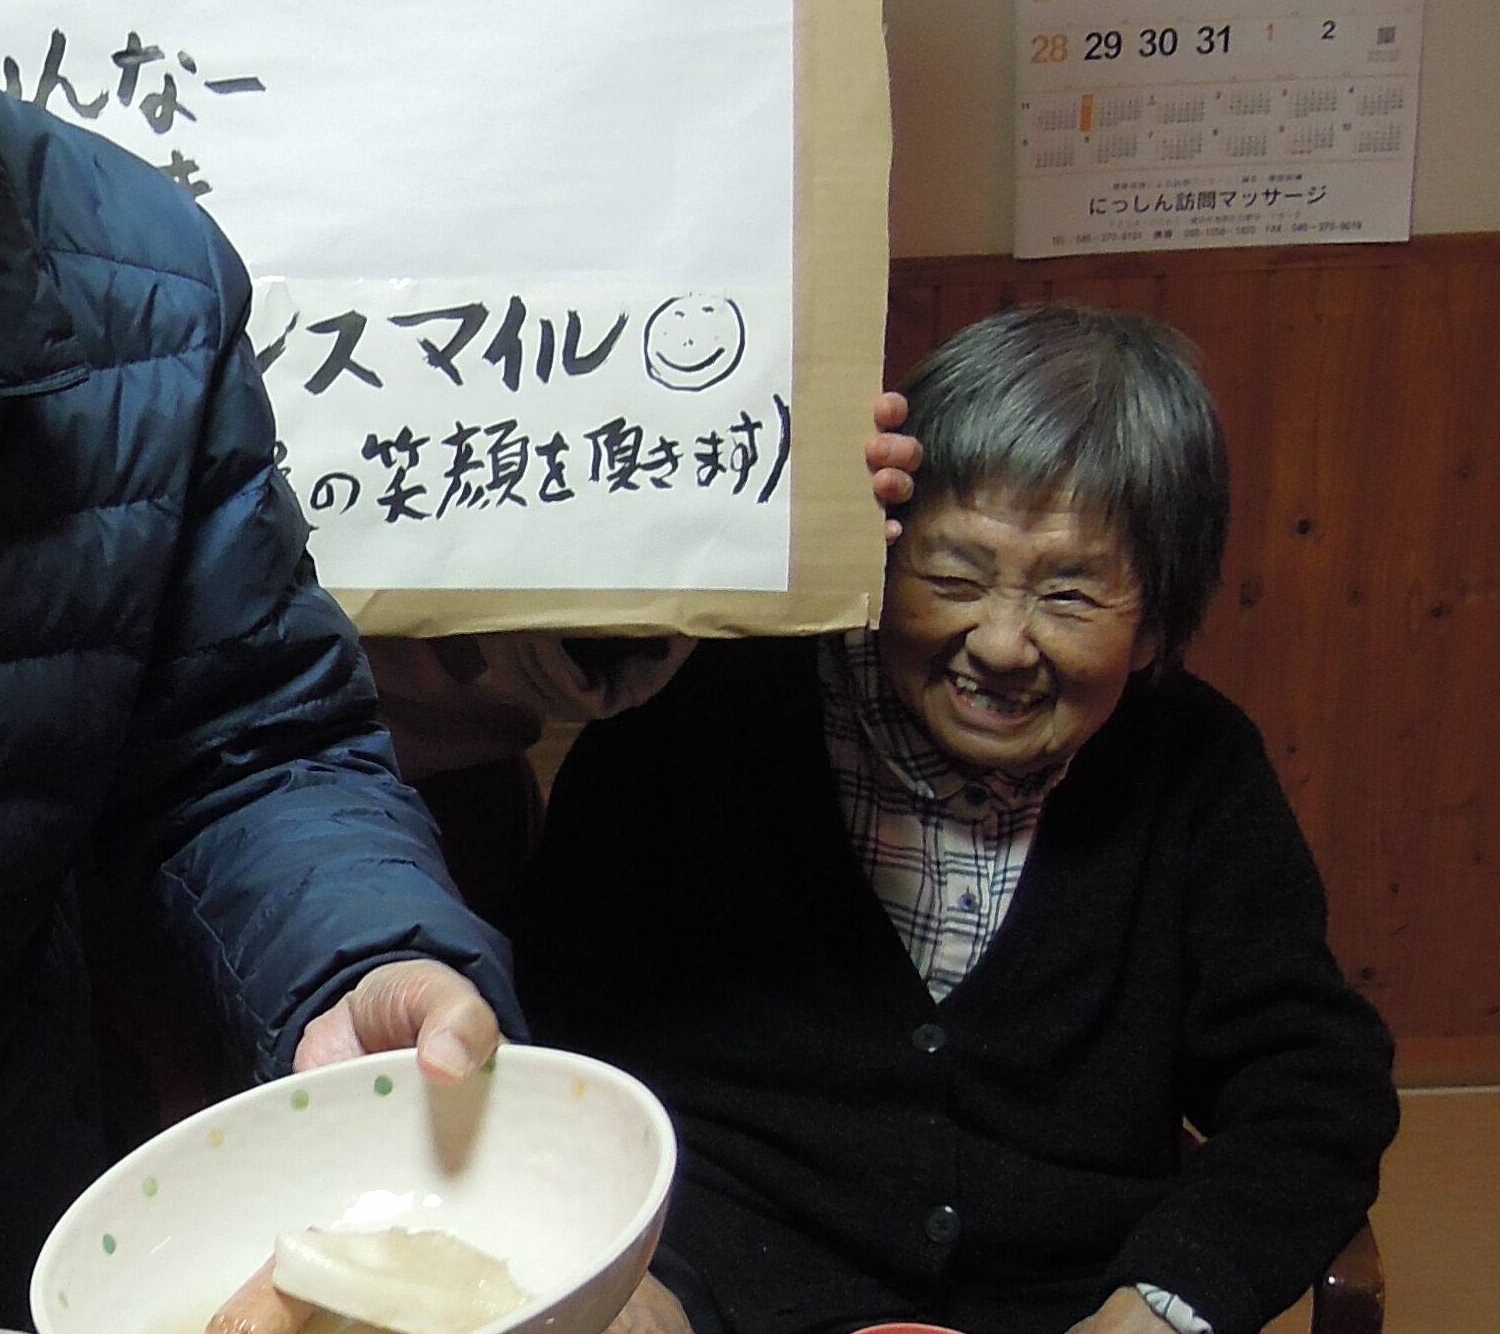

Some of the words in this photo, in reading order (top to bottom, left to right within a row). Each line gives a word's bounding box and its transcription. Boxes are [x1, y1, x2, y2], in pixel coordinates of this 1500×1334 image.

[1030, 34, 1069, 65] 28
[1083, 31, 1123, 62] 29
[1138, 27, 1179, 59] 30
[1195, 24, 1232, 55] 31
[1320, 20, 1337, 41] 2
[1089, 185, 1327, 216] にっしん訪問マッサージ
[273, 394, 792, 523] の笑顔を頂きます)
